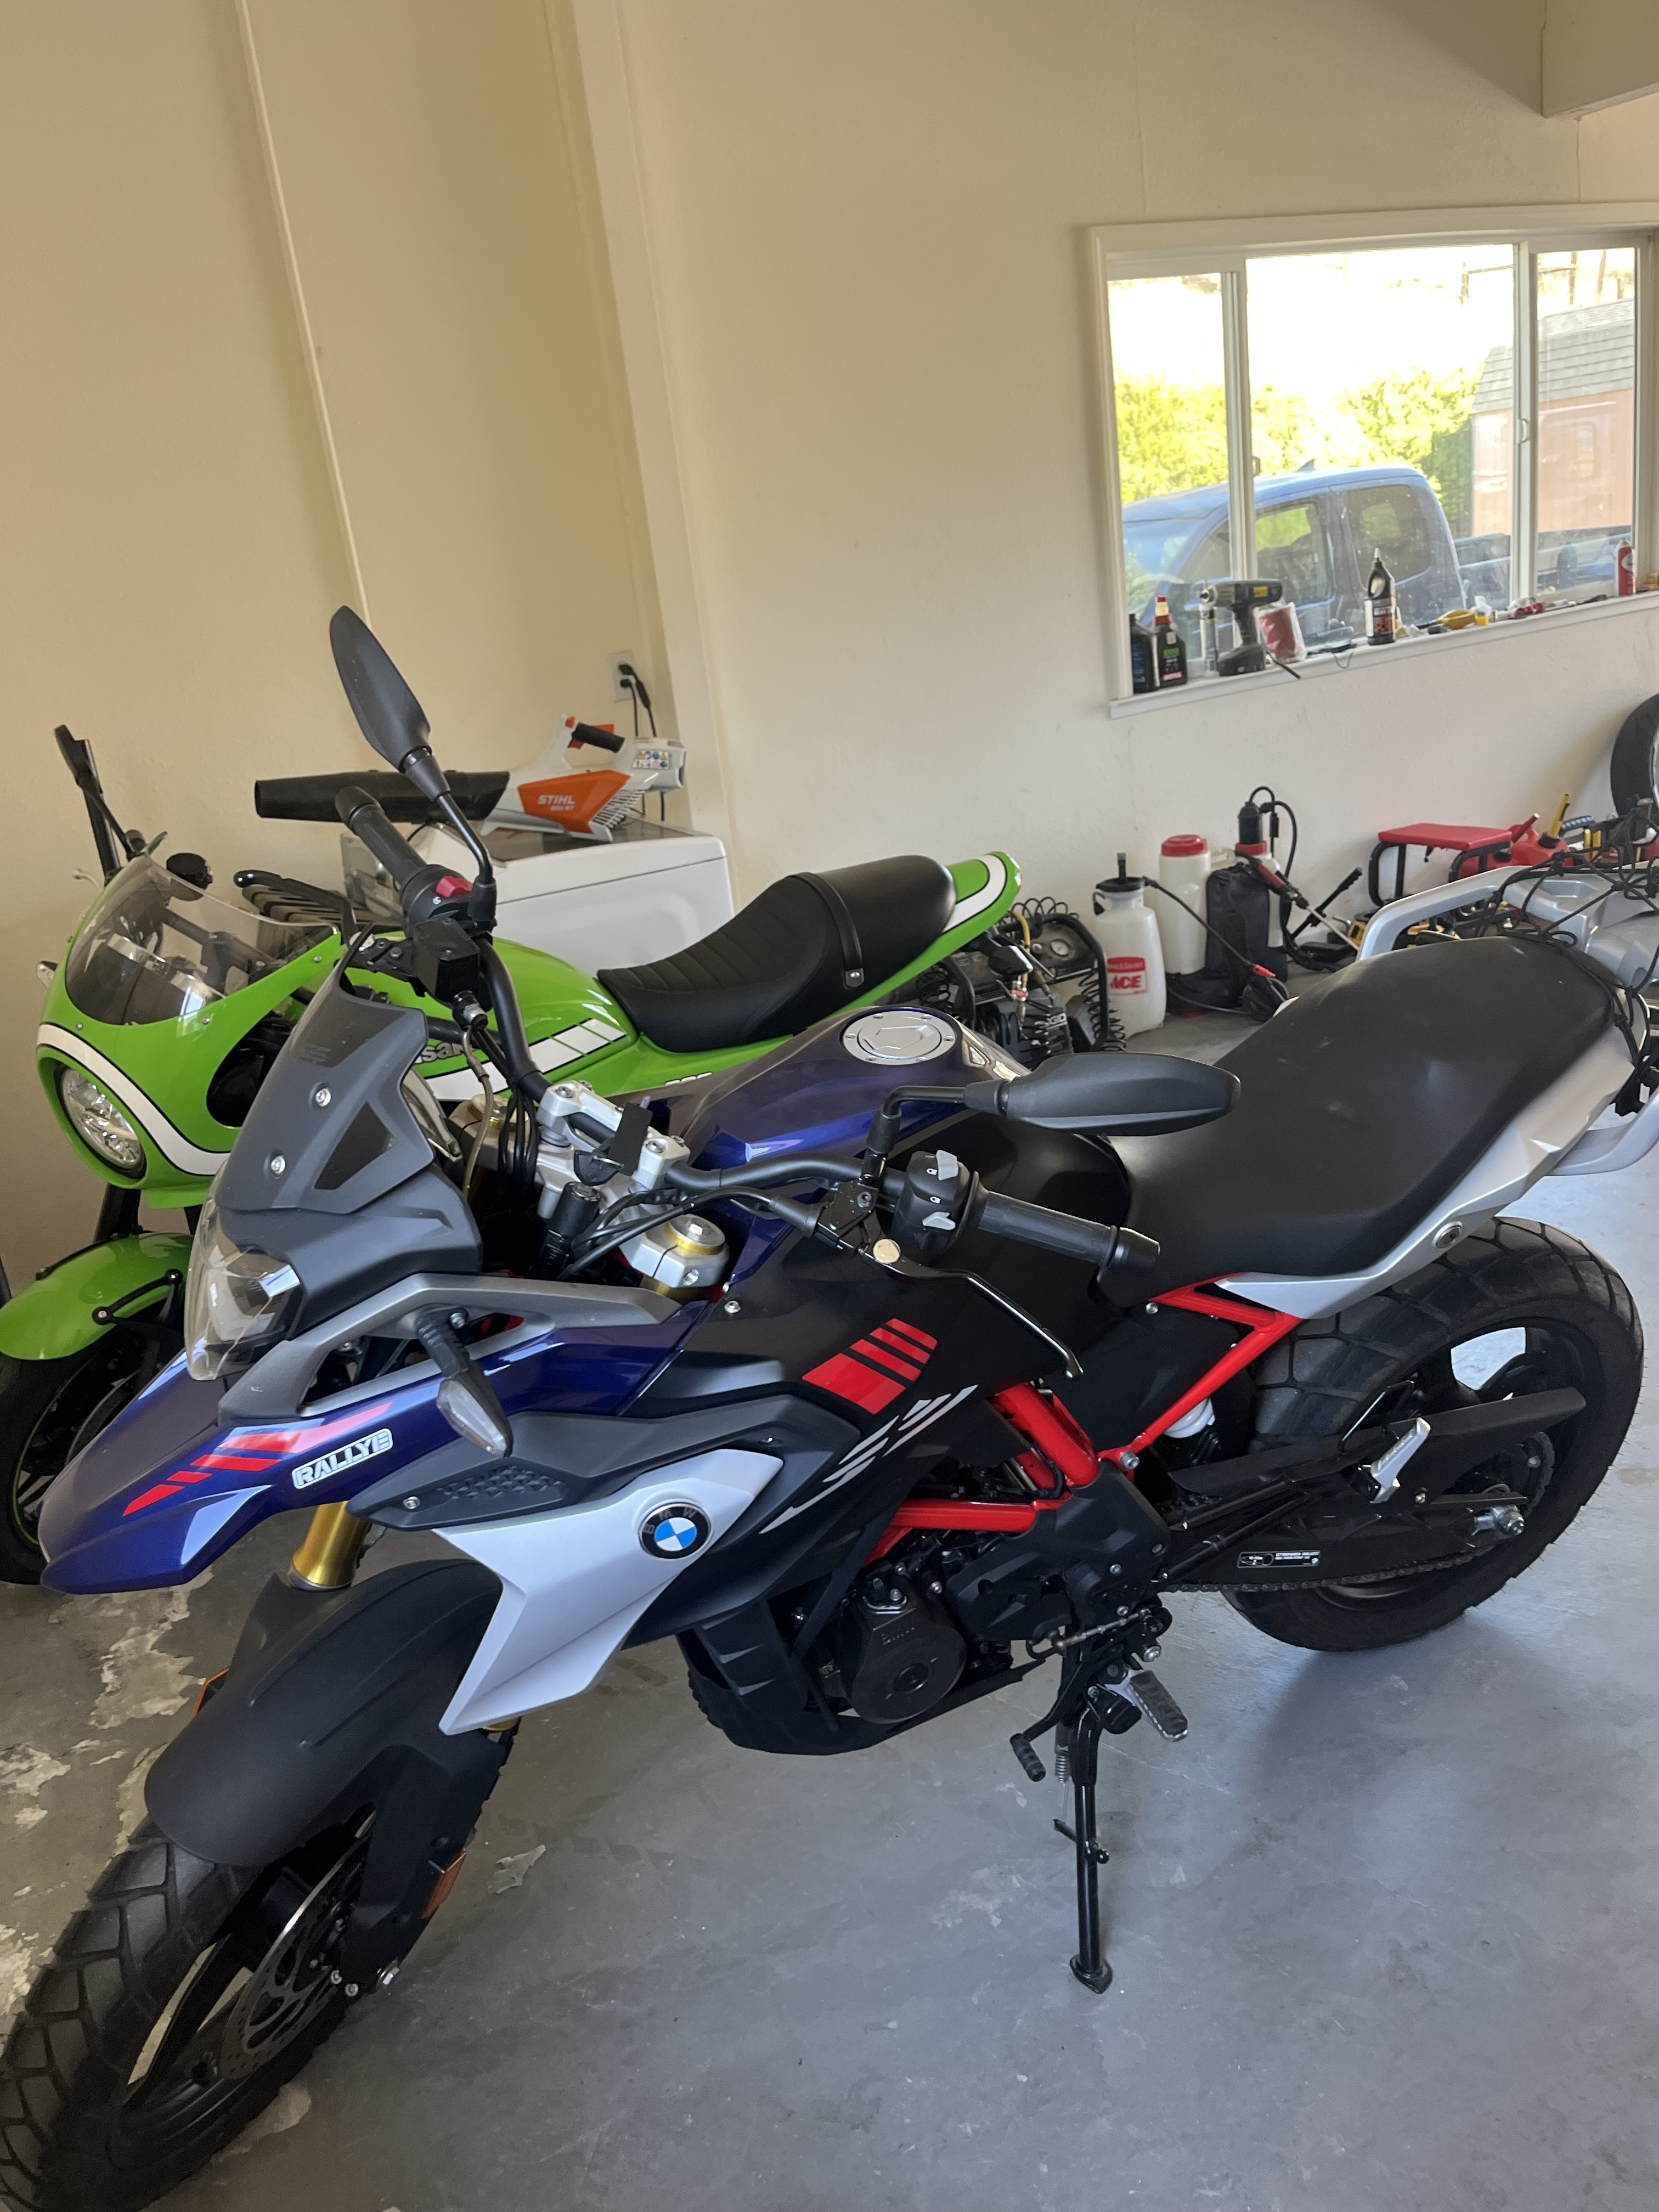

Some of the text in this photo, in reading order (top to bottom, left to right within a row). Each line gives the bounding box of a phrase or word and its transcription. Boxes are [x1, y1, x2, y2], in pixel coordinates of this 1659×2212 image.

[538, 795, 575, 805] STIHL
[1110, 975, 1141, 989] ACE
[295, 1430, 391, 1487] RALLYE
[642, 1506, 698, 1534] BMW
